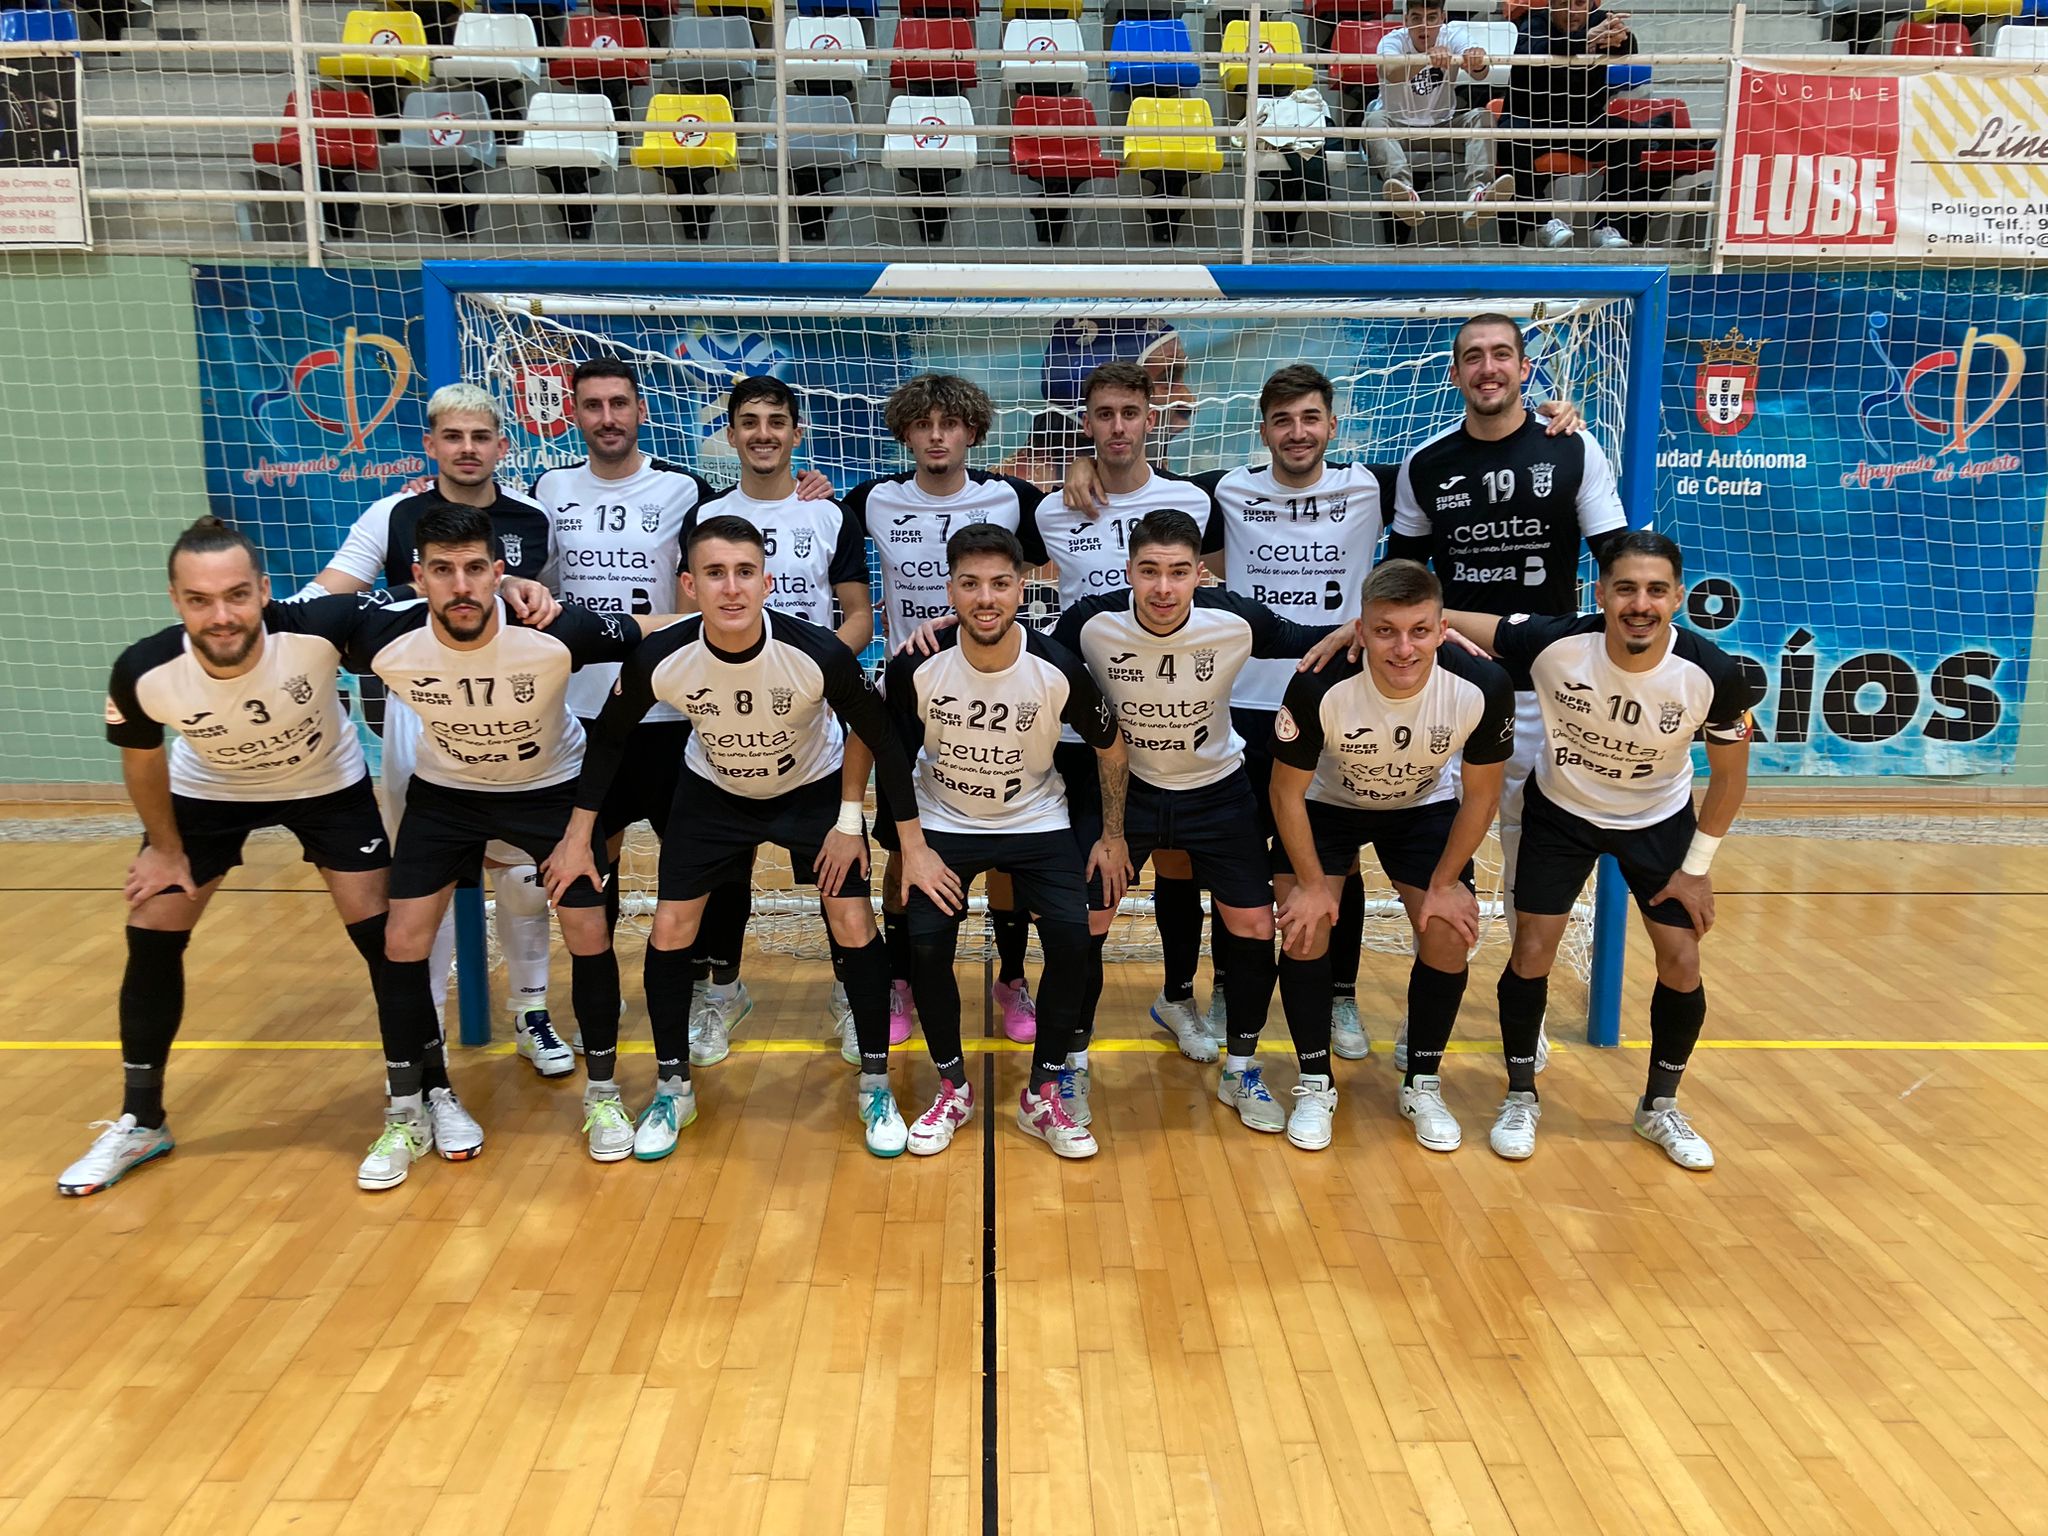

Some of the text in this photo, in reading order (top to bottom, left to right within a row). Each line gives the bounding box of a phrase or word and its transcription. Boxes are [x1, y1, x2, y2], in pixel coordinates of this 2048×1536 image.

[1750, 77, 1890, 102] CUCINE
[1735, 154, 1890, 236] LUBE
[1932, 203, 2018, 218] Poligono
[1928, 233, 1993, 244] e-mail:
[1655, 447, 1807, 470] udad Autónoma
[1481, 469, 1516, 504] 19
[1677, 476, 1763, 497] de Ceuta
[1285, 496, 1320, 522] 14
[1436, 492, 1470, 504] SUPER
[1436, 499, 1472, 511] SPORT
[594, 504, 627, 533] 13
[1068, 537, 1100, 546] SUPER
[1069, 544, 1102, 552] SPORT
[901, 561, 951, 578] ceu
[1453, 561, 1518, 583] Baeza
[770, 573, 808, 594] uta
[1252, 585, 1317, 605] Baeza
[1107, 667, 1143, 675] SUPER
[1108, 673, 1145, 682] SPORT
[1156, 654, 1177, 684] 4
[410, 690, 449, 700] SUPER
[411, 696, 452, 705] SPORT
[457, 677, 495, 707] 17
[734, 690, 753, 716] 8
[1555, 690, 1591, 708] SUPER
[243, 699, 271, 726] 3
[966, 700, 1009, 733] 22
[1607, 694, 1642, 727] 10
[1392, 725, 1412, 752] 9
[1554, 746, 1623, 780] Baeza
[931, 766, 996, 799] Baeza
